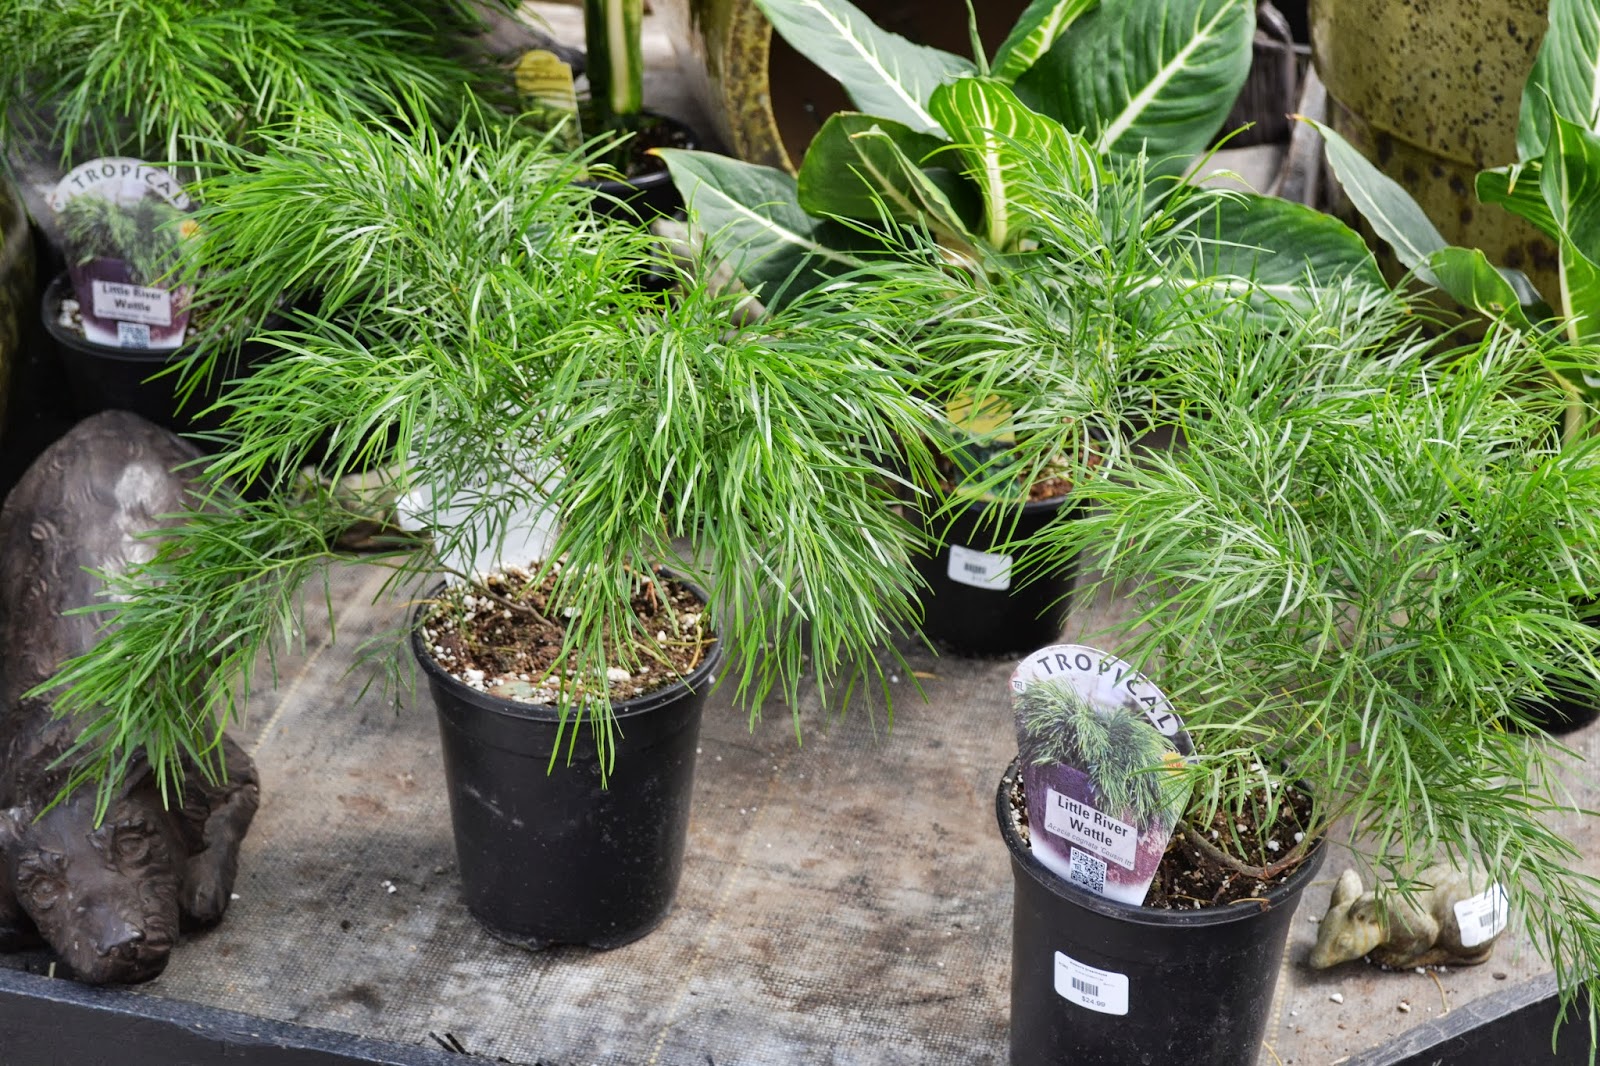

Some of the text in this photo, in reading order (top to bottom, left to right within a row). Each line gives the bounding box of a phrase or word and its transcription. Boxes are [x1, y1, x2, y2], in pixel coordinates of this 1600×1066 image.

[102, 283, 130, 297] Little
[1037, 652, 1172, 729] TROPICAL
[1047, 822, 1071, 838] Acacia
[1057, 795, 1129, 837] Little River
[1069, 816, 1113, 847] Wattle
